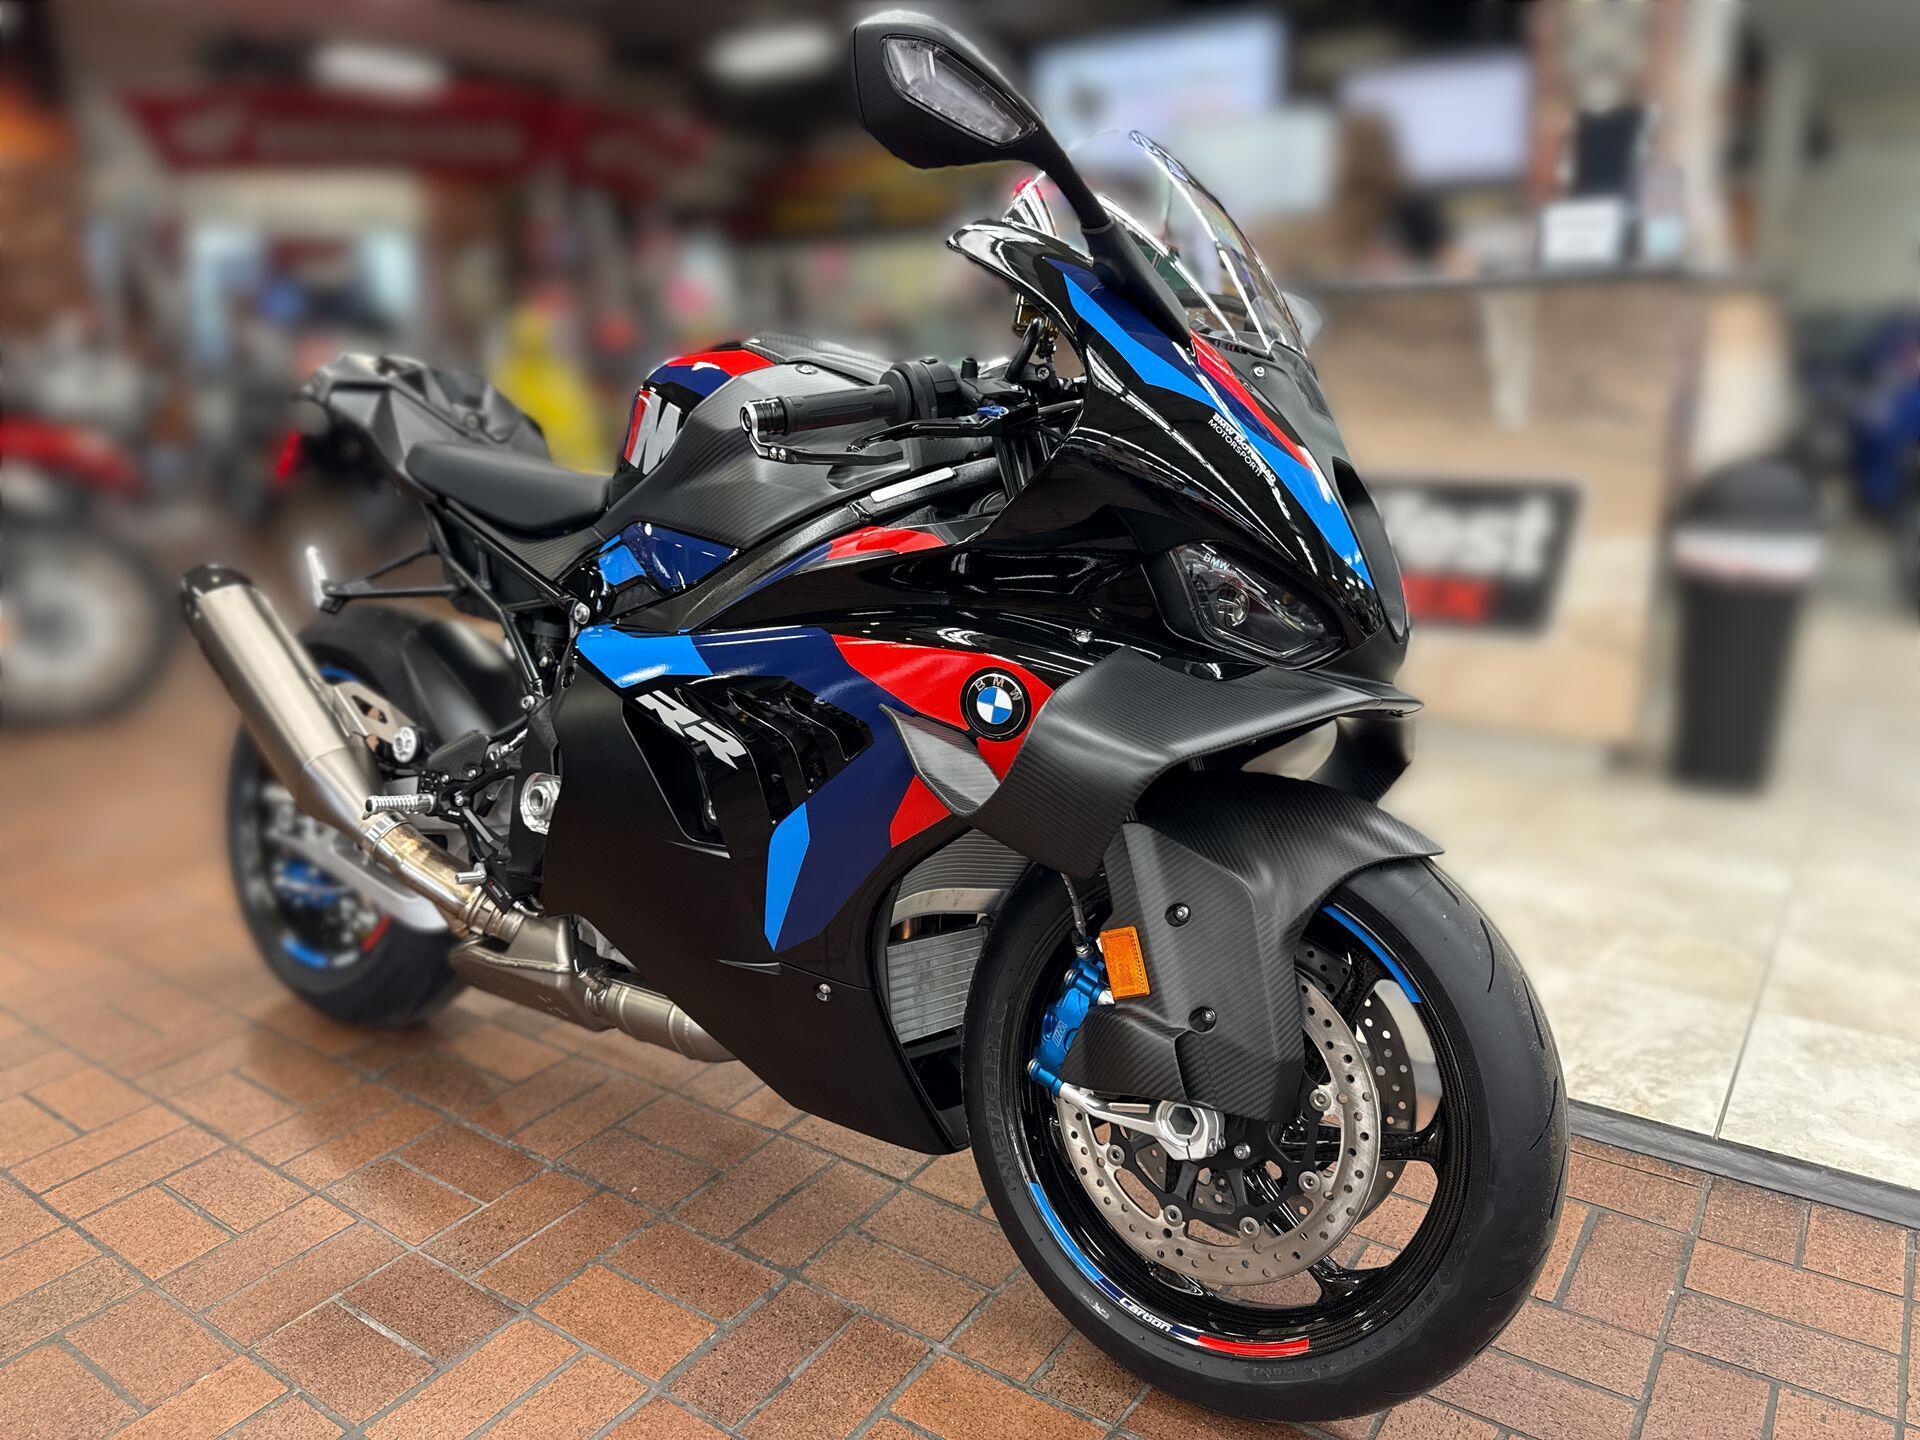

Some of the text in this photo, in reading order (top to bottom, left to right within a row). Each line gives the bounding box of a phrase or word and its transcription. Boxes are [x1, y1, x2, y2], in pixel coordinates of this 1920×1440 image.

[626, 391, 681, 475] M
[1212, 411, 1235, 435] BMW
[1207, 419, 1263, 477] MOTORSPORT
[1203, 552, 1230, 570] BMW
[975, 676, 1021, 701] BMW
[635, 690, 747, 770] RR
[1119, 1297, 1173, 1332] Carbon
